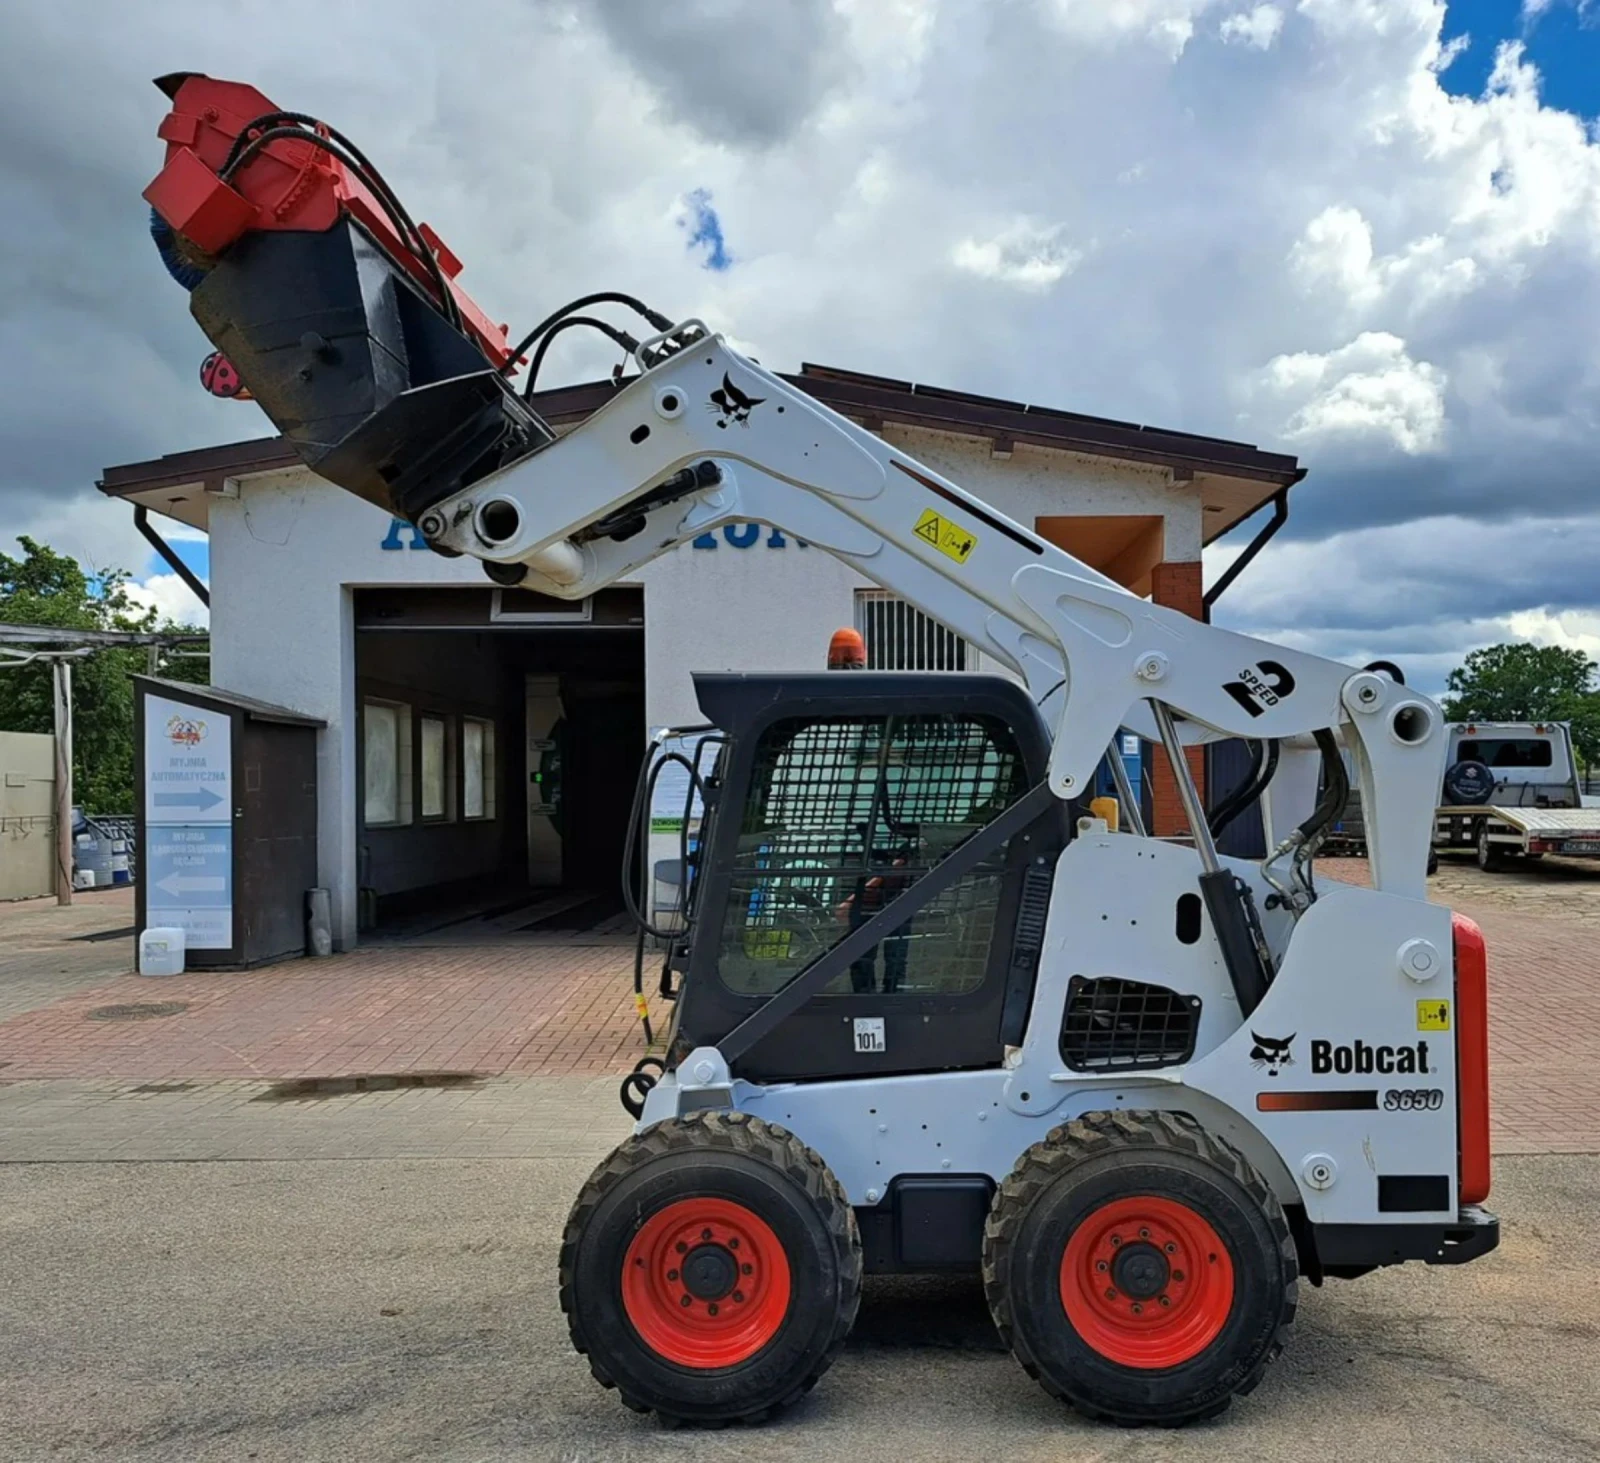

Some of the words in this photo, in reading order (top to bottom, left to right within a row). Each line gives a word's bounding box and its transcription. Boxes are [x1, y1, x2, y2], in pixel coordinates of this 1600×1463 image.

[1221, 660, 1295, 718] 2
[1238, 669, 1279, 706] SPEED
[856, 1032, 876, 1050] 101
[1310, 1039, 1430, 1075] Bobcat
[1384, 1089, 1444, 1111] S650
